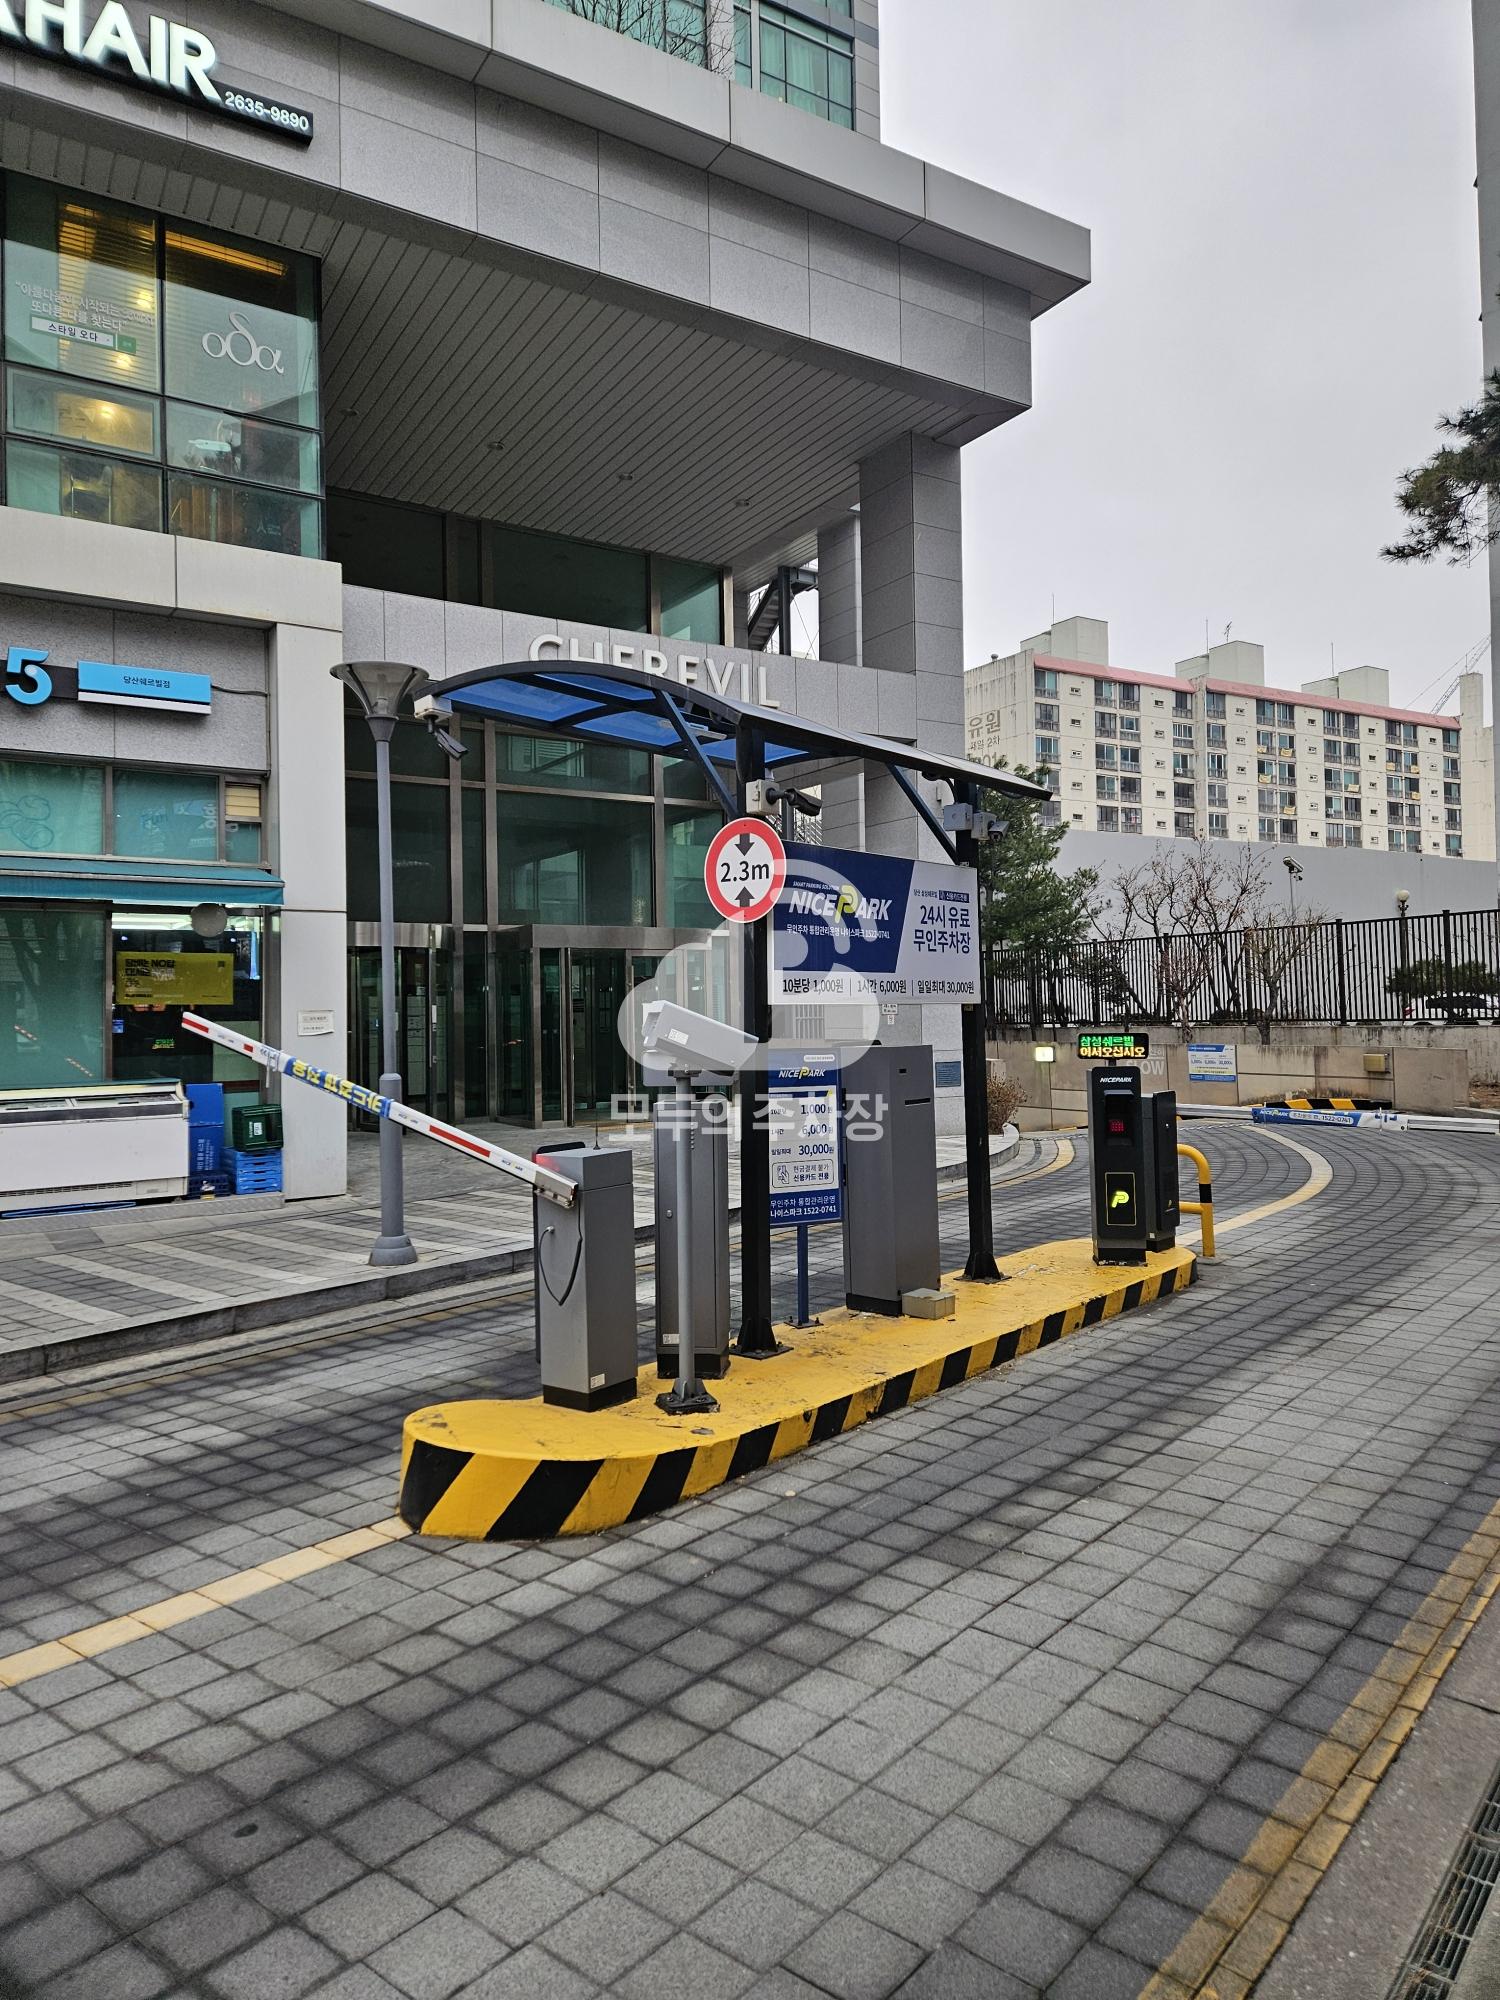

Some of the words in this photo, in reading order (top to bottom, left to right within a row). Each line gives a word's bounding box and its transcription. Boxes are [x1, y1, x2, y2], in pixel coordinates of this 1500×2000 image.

[225, 91, 310, 132] 2635-9890
[48, 323, 76, 336] 스타일
[79, 329, 98, 342] 오다
[5, 646, 53, 705] 5
[123, 675, 171, 689] 당산쉐르빌점
[968, 709, 1001, 739] 유원
[987, 735, 1000, 748] 2차
[720, 860, 771, 883] 2.3m
[788, 884, 893, 924] NICEPARK
[920, 904, 946, 928] 24시
[948, 906, 971, 928] 유료
[786, 923, 808, 934] 무인주차
[809, 924, 840, 937] 통합관리운영
[840, 927, 864, 938] 나이스파크
[913, 929, 971, 954] 무인주차장
[782, 977, 810, 994] 10분당
[813, 978, 844, 994] 1,000원
[857, 979, 877, 994] 1시간
[879, 980, 907, 995] 6,000원
[917, 980, 945, 994] 일일최대
[946, 981, 975, 995] 30,000원
[1080, 1046, 1146, 1058] 어서오십시오
[778, 1066, 826, 1080] NICEPARK
[1322, 1115, 1350, 1124] 1522-0741
[793, 1164, 817, 1174] 현금결제
[793, 1173, 817, 1182] 신용카드
[818, 1172, 830, 1181] 전용
[770, 1198, 797, 1209] 무인주차
[798, 1195, 836, 1207] 통합관리운영
[770, 1207, 803, 1218] 나이스파크
[803, 1204, 837, 1216] 1522-0741
